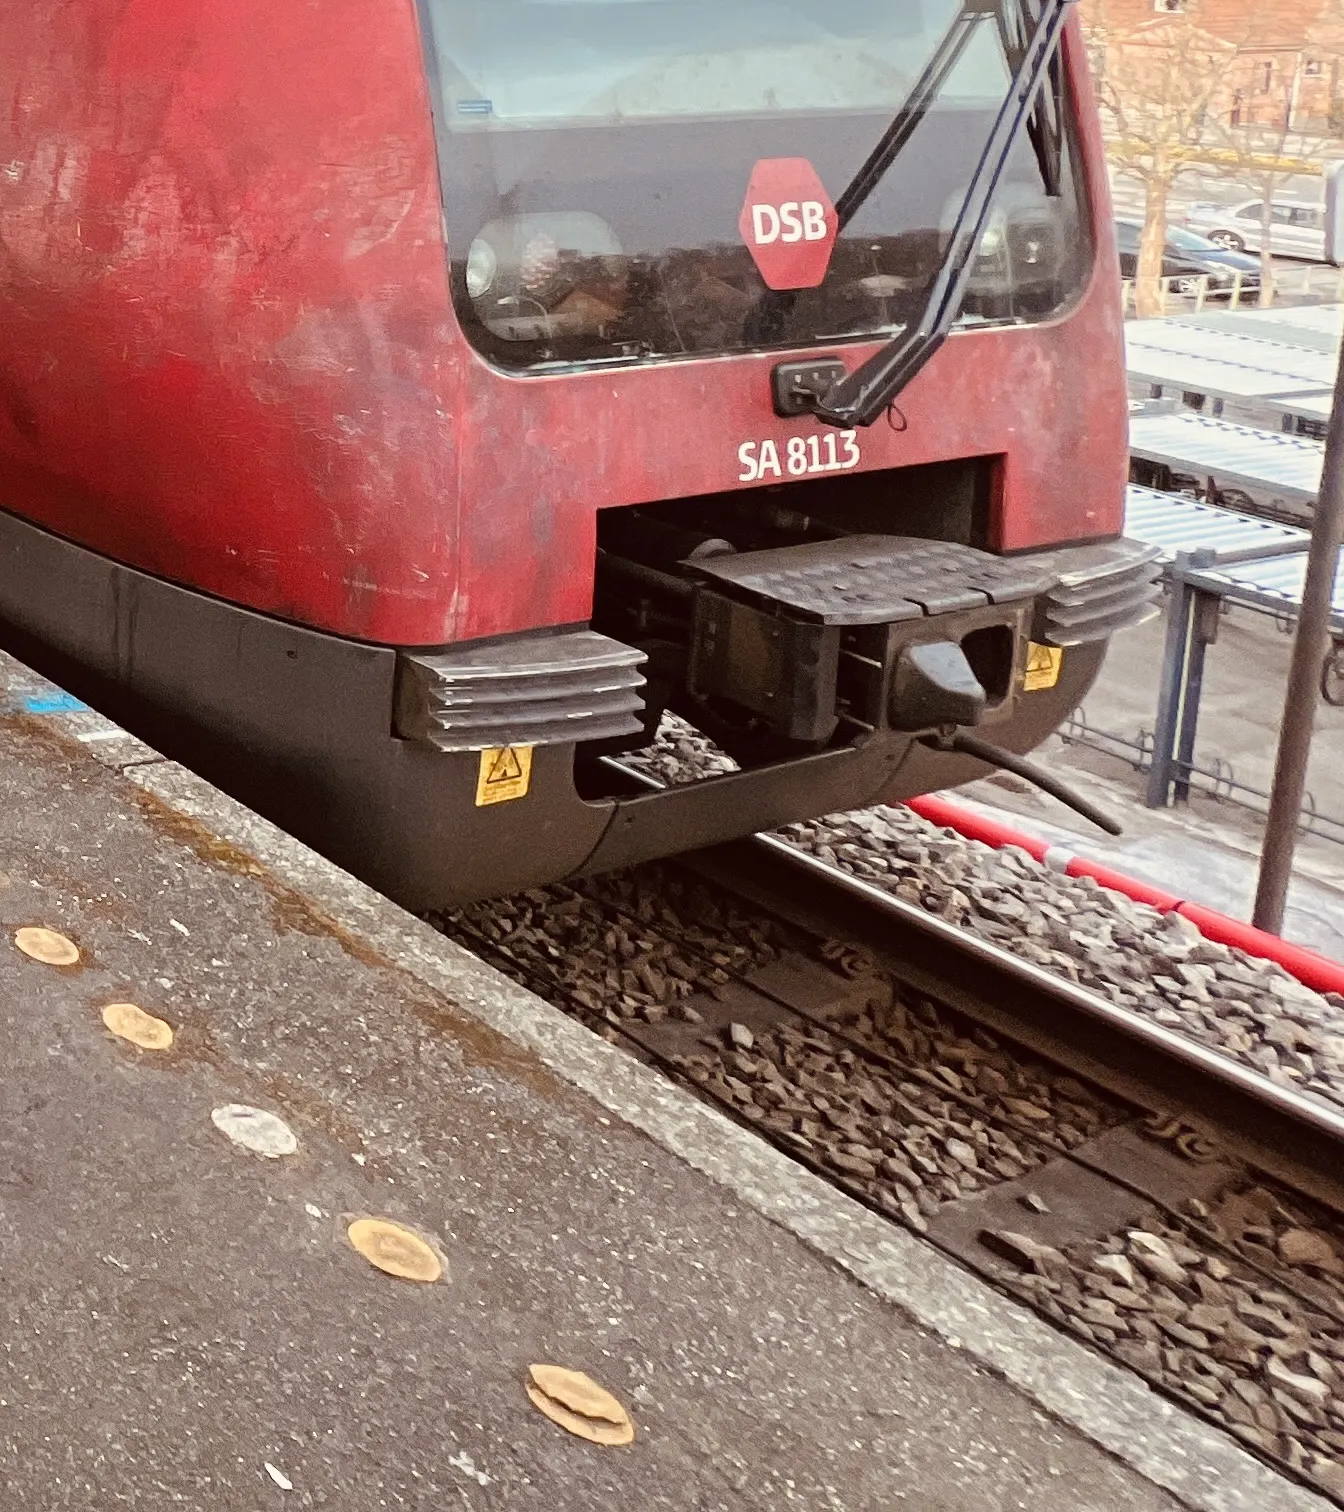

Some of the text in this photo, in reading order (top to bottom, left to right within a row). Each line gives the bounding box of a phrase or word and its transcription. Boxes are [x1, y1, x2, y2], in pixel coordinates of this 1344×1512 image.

[752, 201, 827, 245] DSB
[738, 429, 861, 482] SA 8113
